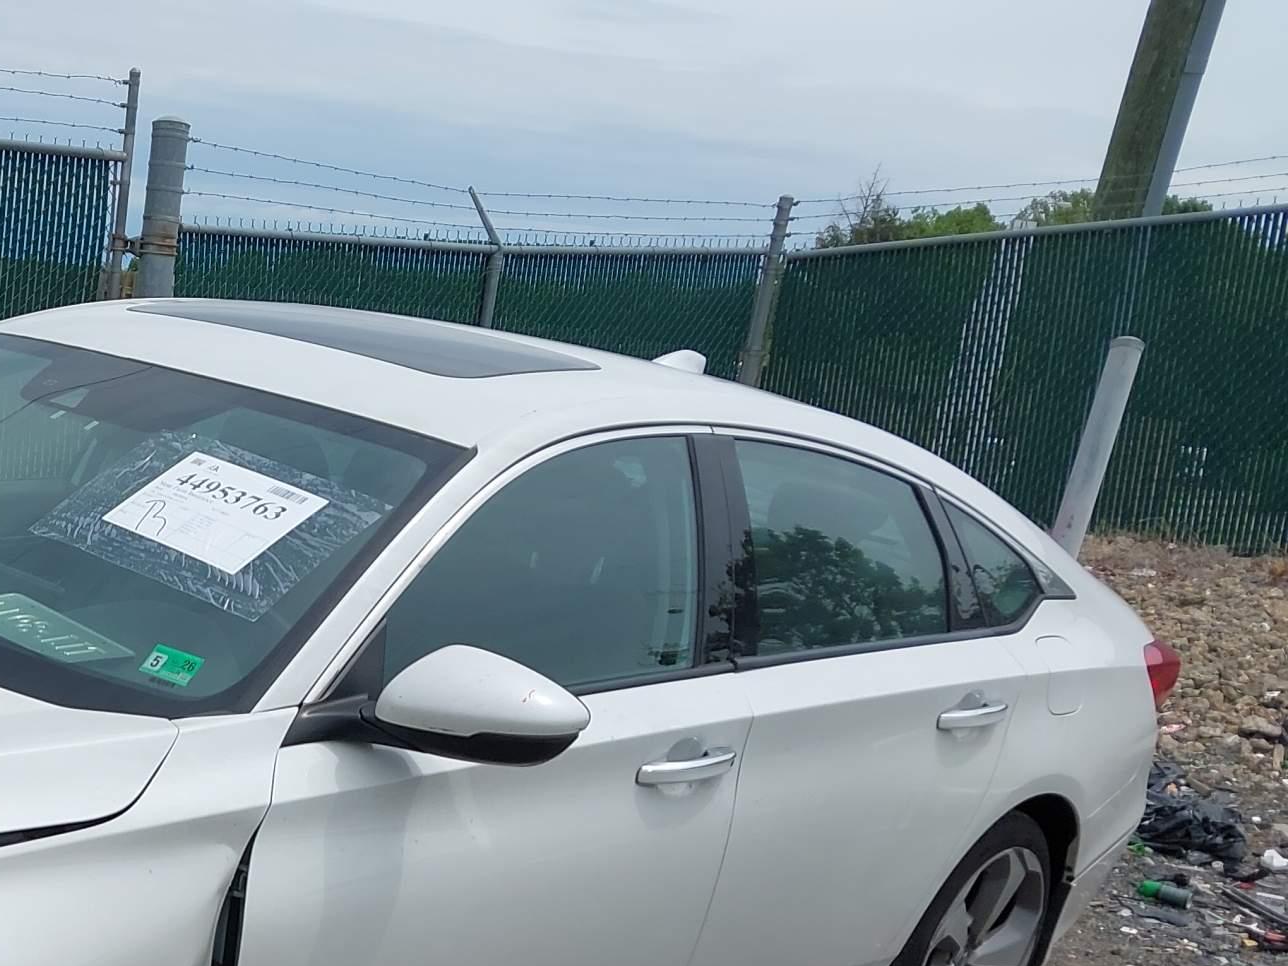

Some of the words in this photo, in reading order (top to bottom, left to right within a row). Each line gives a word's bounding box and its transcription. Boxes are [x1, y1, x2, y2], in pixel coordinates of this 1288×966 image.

[176, 473, 287, 520] 44953763
[150, 655, 163, 668] 5
[183, 659, 197, 672] 26
